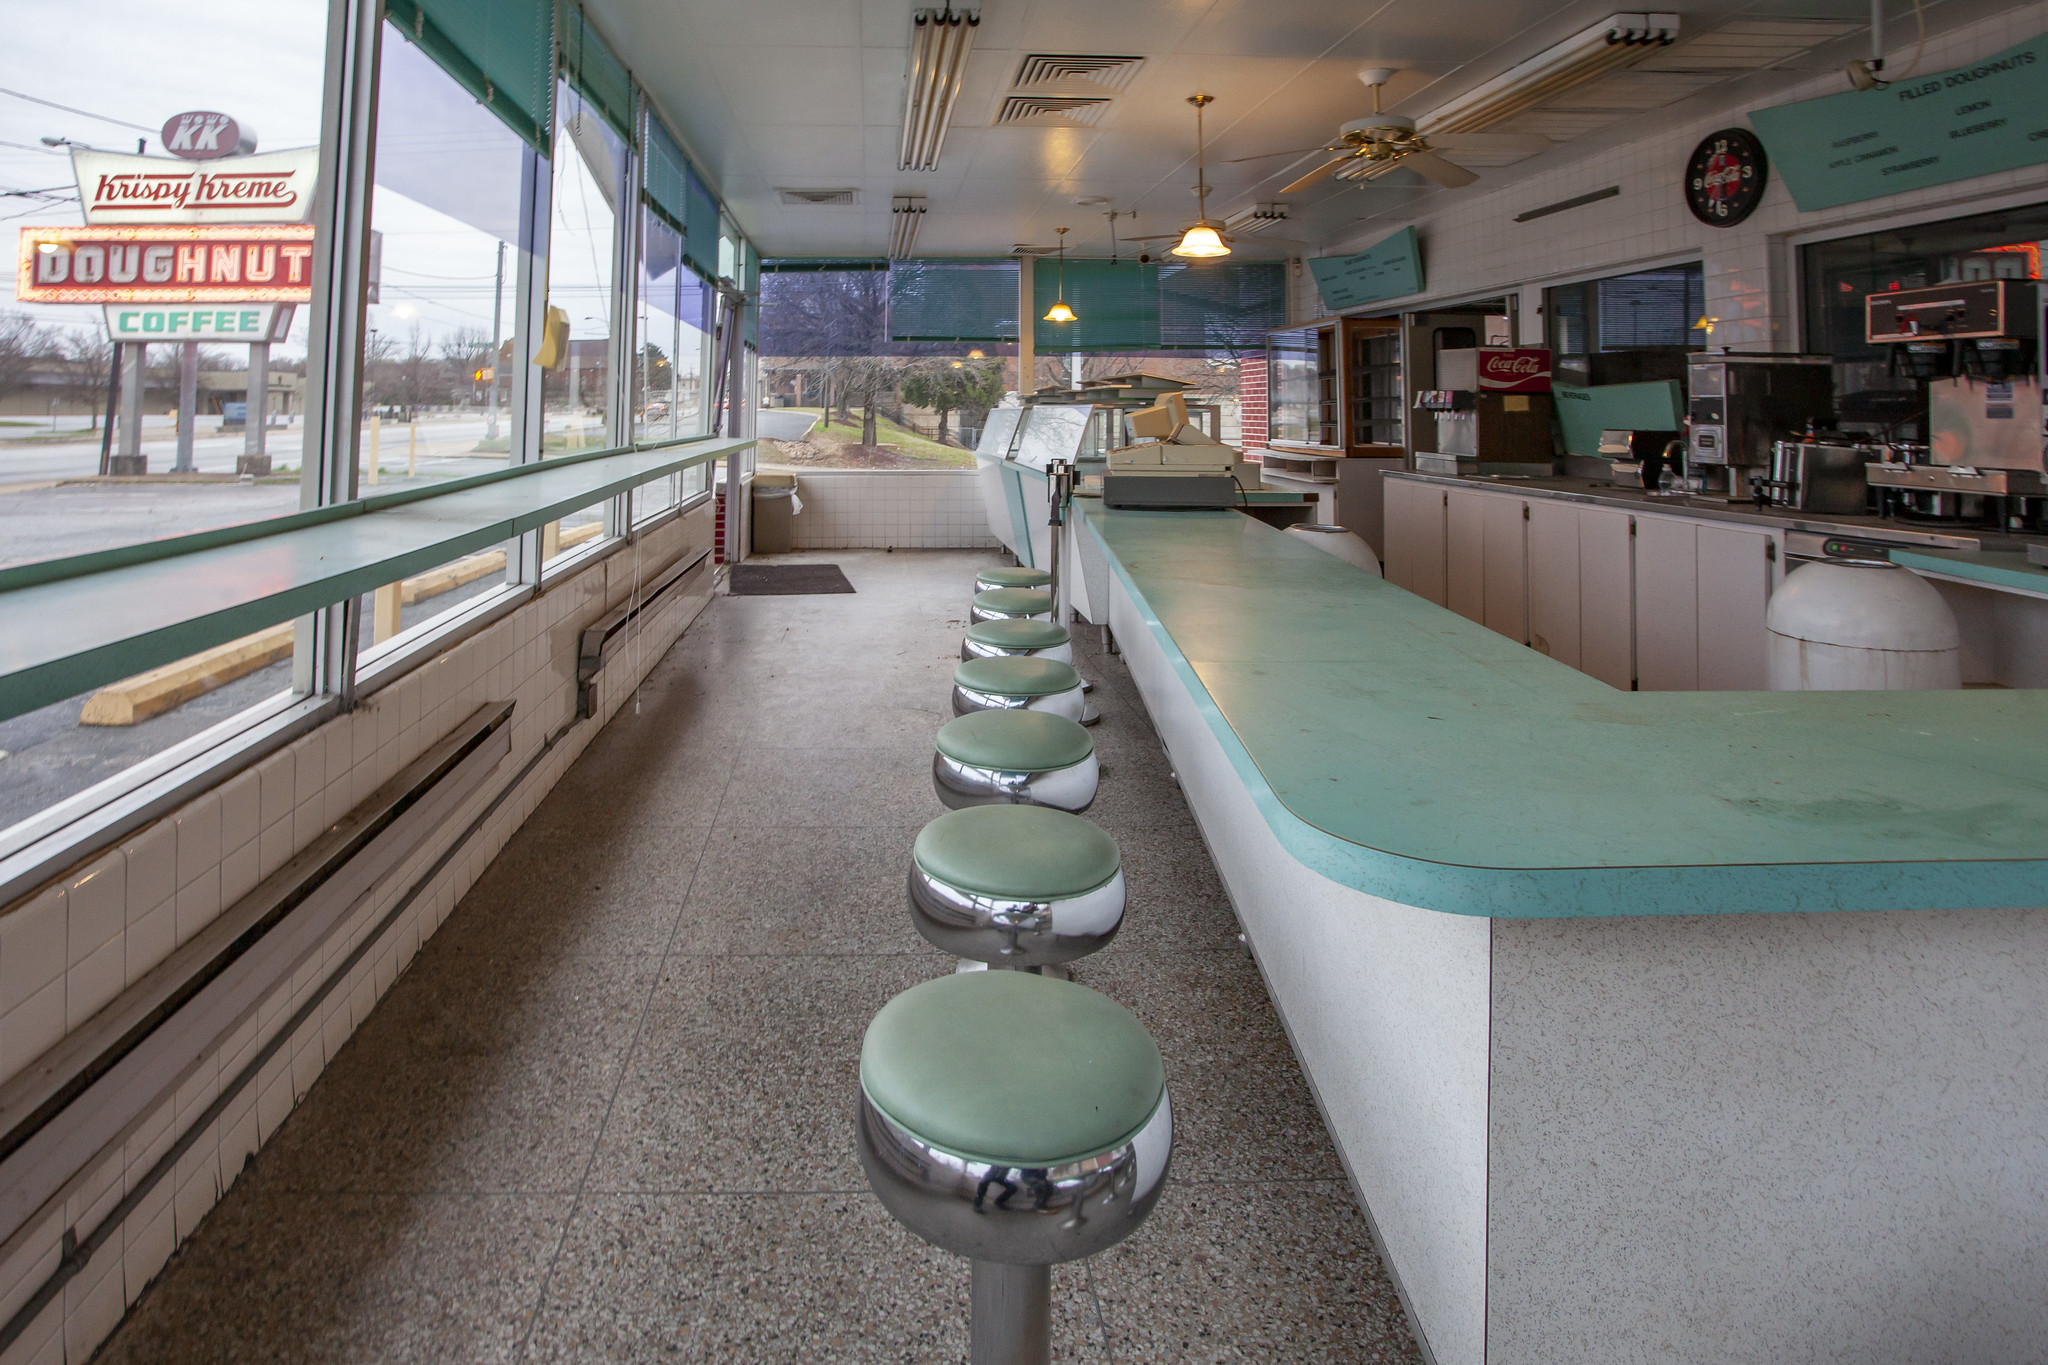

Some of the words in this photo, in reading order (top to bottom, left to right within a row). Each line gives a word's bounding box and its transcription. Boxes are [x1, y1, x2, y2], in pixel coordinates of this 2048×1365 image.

[1898, 81, 1942, 101] FILLED
[1944, 51, 2037, 88] DOUGHNUTS
[1953, 99, 1992, 116] LEMON
[168, 118, 229, 150] KK
[1714, 140, 1728, 154] 12
[92, 171, 196, 211] Krispy
[192, 169, 298, 209] Kreme
[38, 243, 313, 284] DOUGHNUT
[118, 310, 261, 333] COFFEE
[1486, 355, 1540, 374] Coca-Cola
